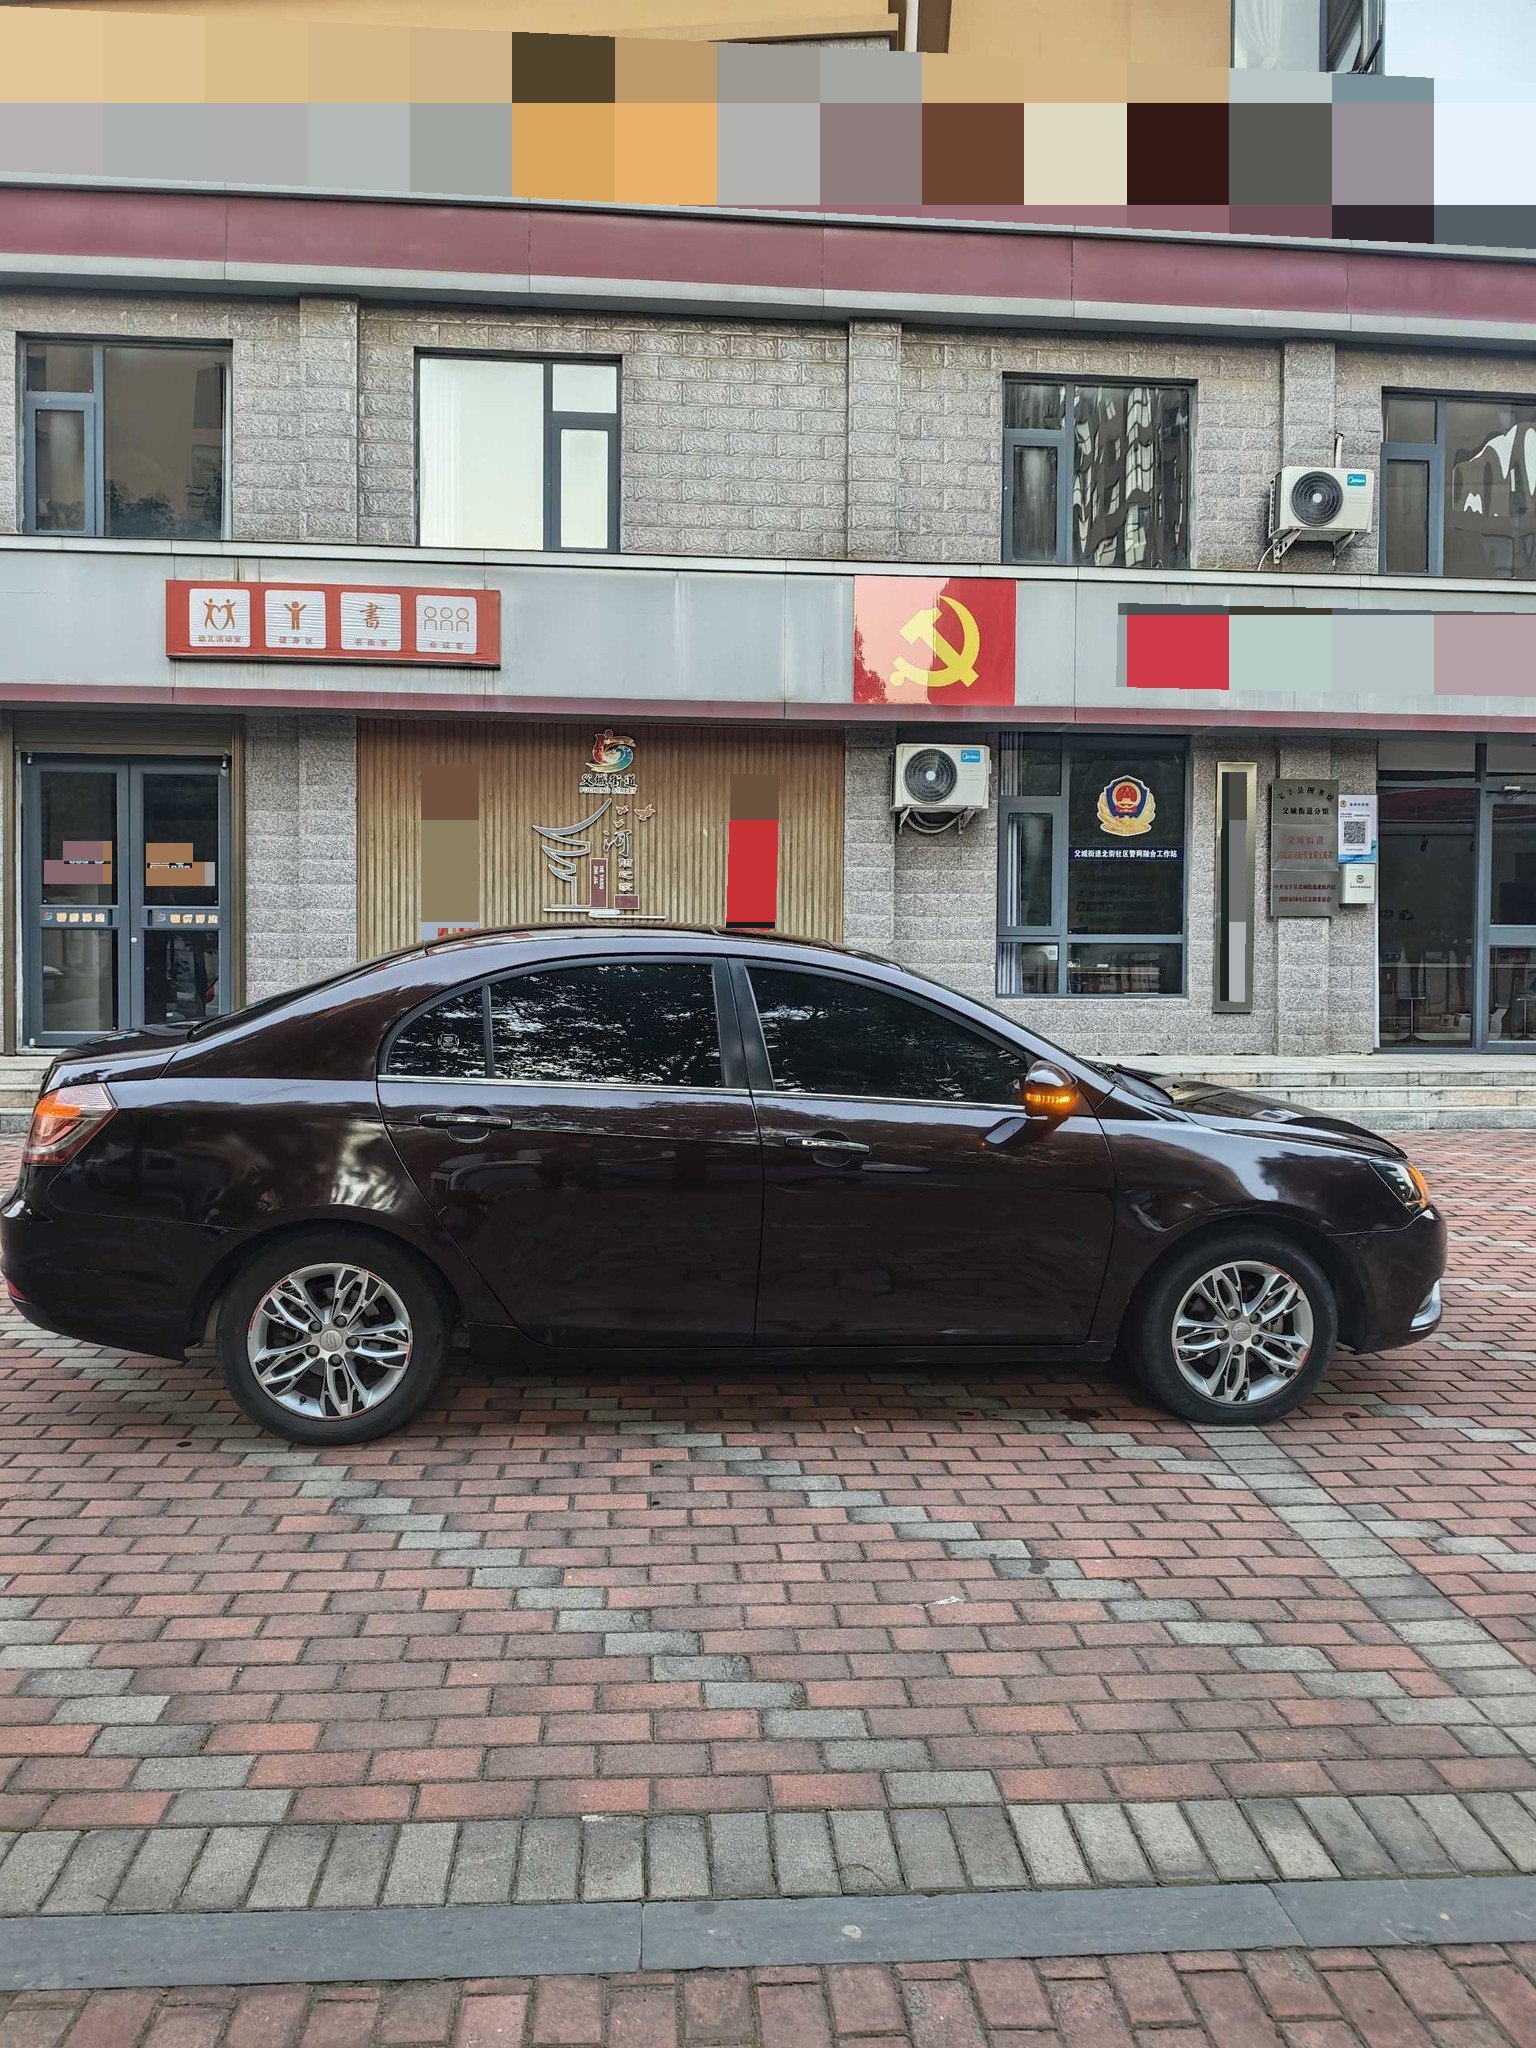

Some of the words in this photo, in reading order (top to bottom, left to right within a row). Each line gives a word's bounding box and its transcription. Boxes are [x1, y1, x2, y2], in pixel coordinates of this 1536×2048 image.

[580, 773, 637, 788] 父城街道
[1282, 806, 1330, 816] 父城街道分馆
[1074, 849, 1178, 859] 父城街道北街社区警网融合工作站
